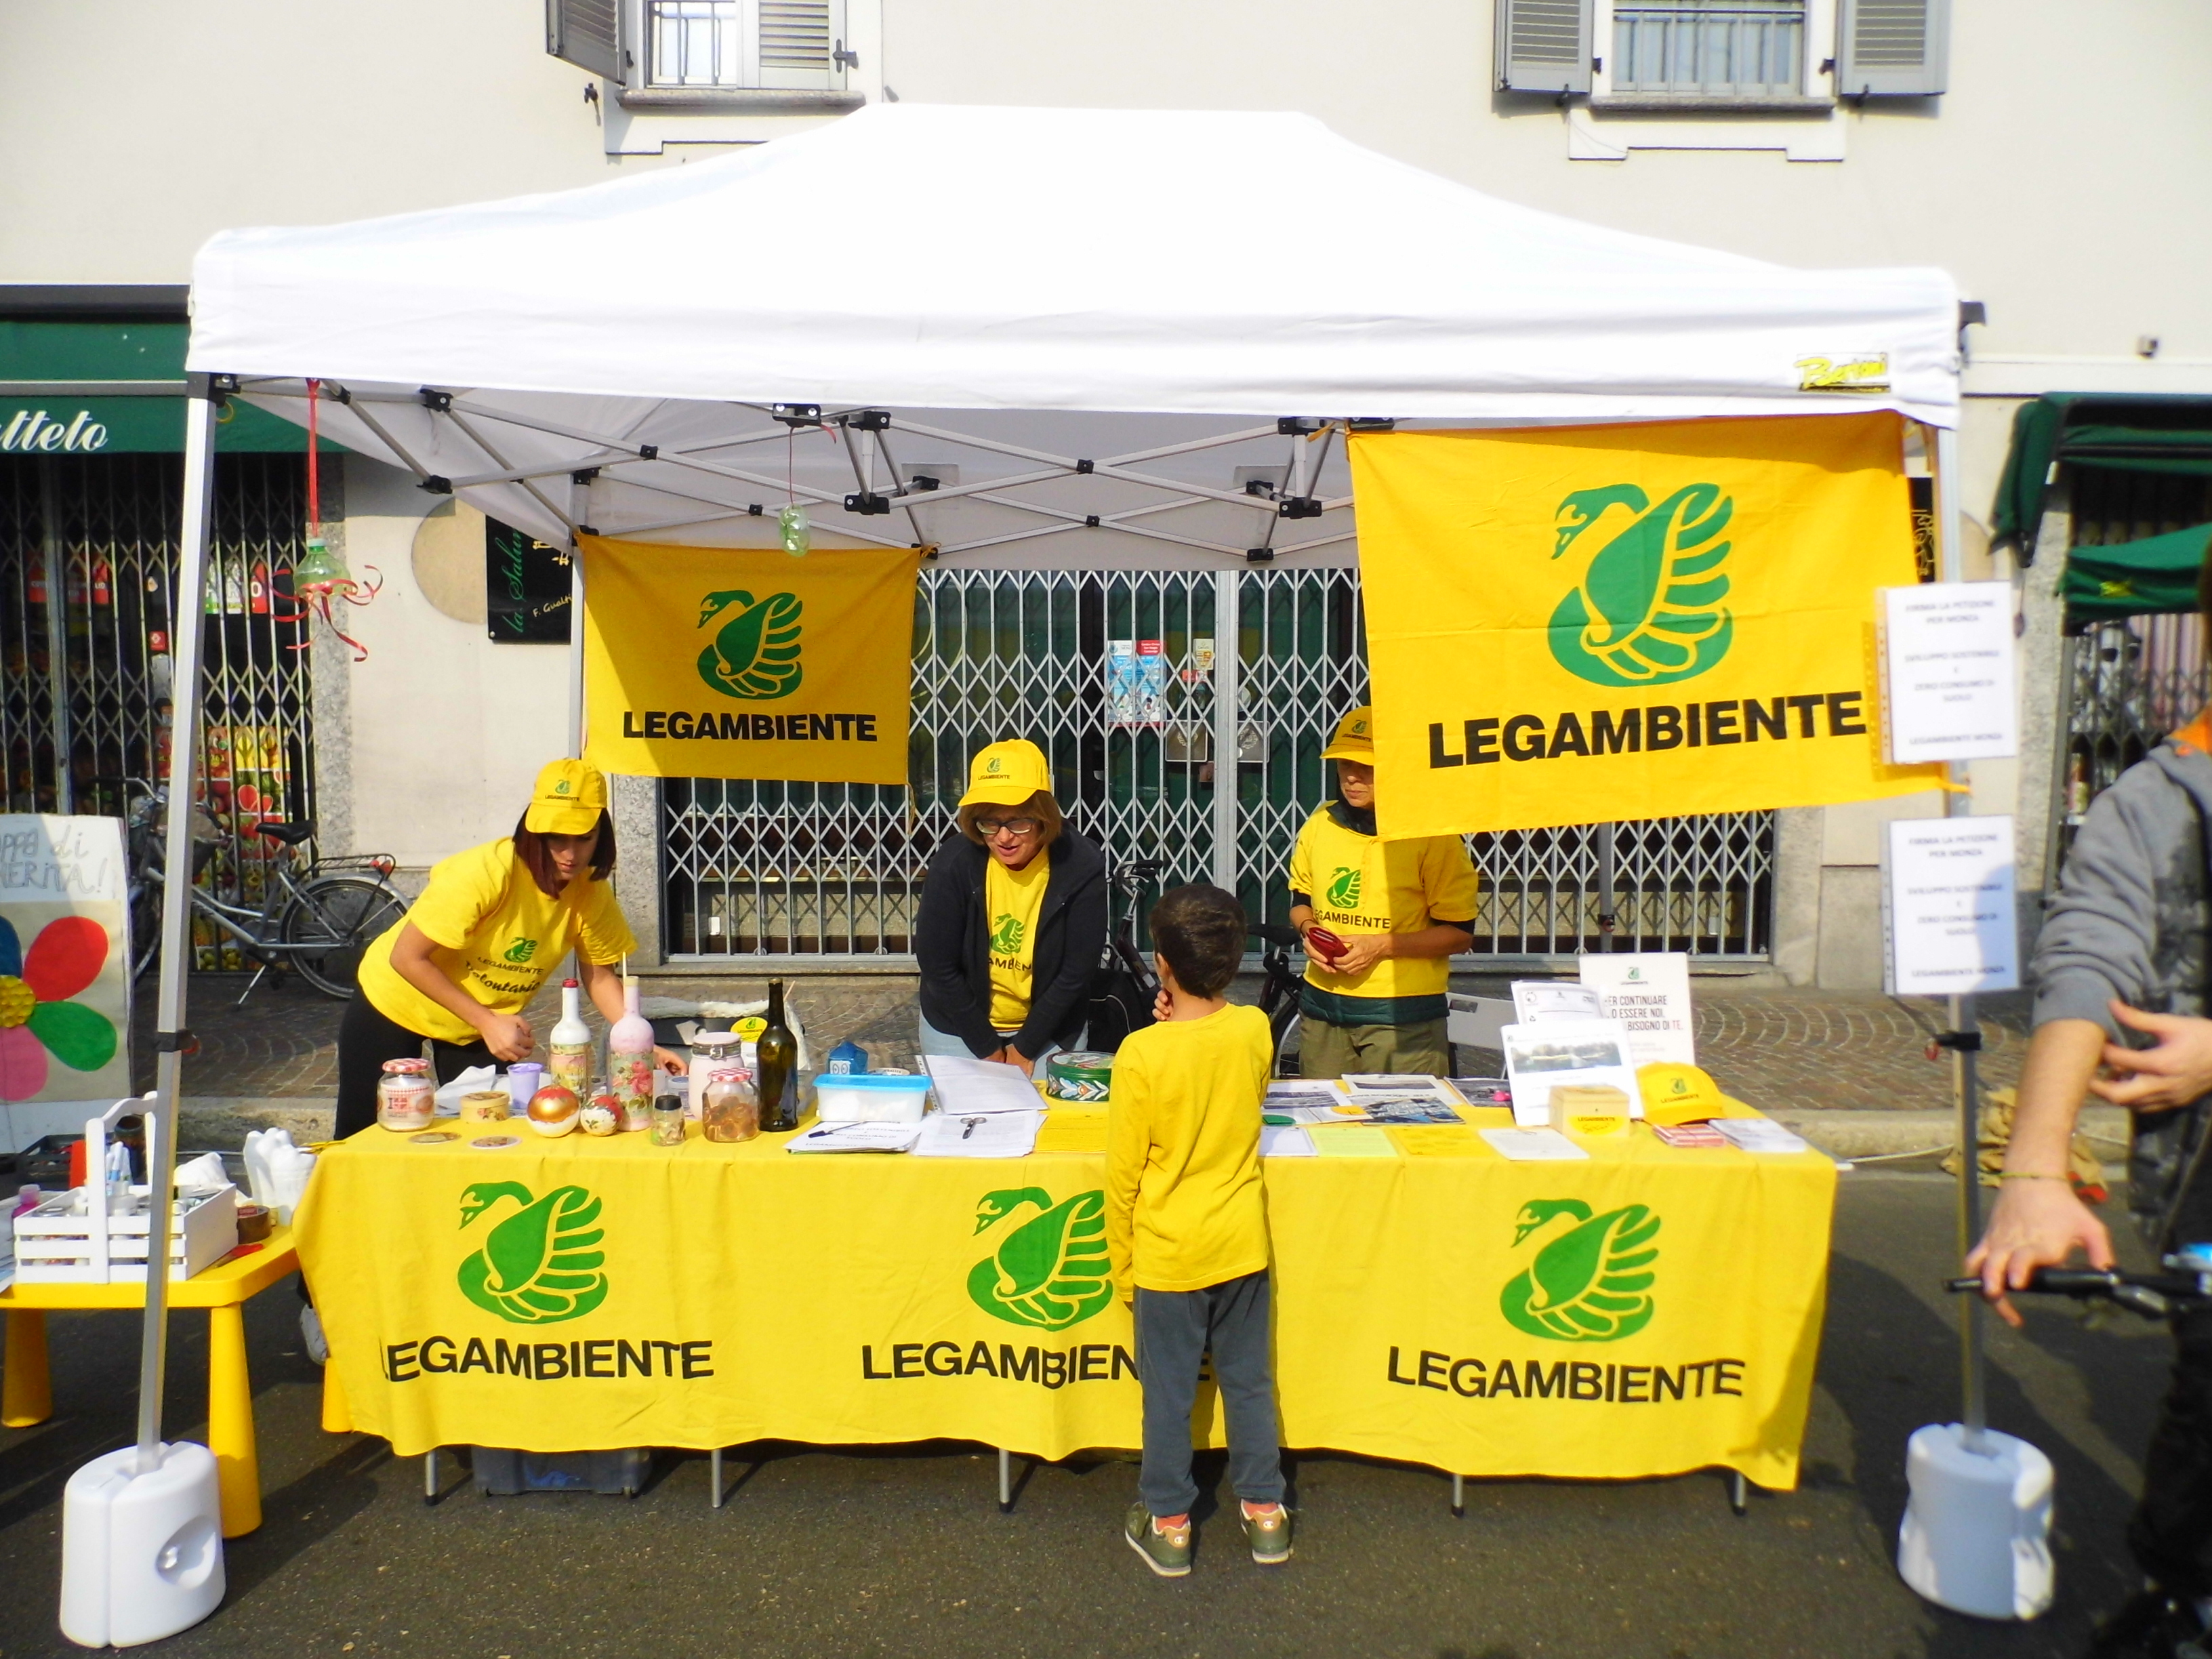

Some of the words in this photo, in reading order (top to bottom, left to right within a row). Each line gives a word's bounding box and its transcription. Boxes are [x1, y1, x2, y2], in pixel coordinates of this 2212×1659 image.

[0, 409, 108, 451] tteto
[623, 712, 877, 741] LEGAMBIENTE
[1429, 691, 1866, 769] LEGAMBIENTE
[1315, 909, 1391, 929] EGAMBIENTE
[477, 956, 544, 975] LEGAMBIENTE
[1605, 996, 1617, 1006] ER
[1620, 995, 1667, 1005] CONTINUARE
[1619, 1008, 1647, 1018] ESSERE
[1628, 1021, 1660, 1031] BISOGNO
[379, 1336, 714, 1382] EGAMBIENTE
[862, 1340, 1141, 1389] LEGAMBIEN
[1388, 1345, 1745, 1402] LEGAMBIENTE
